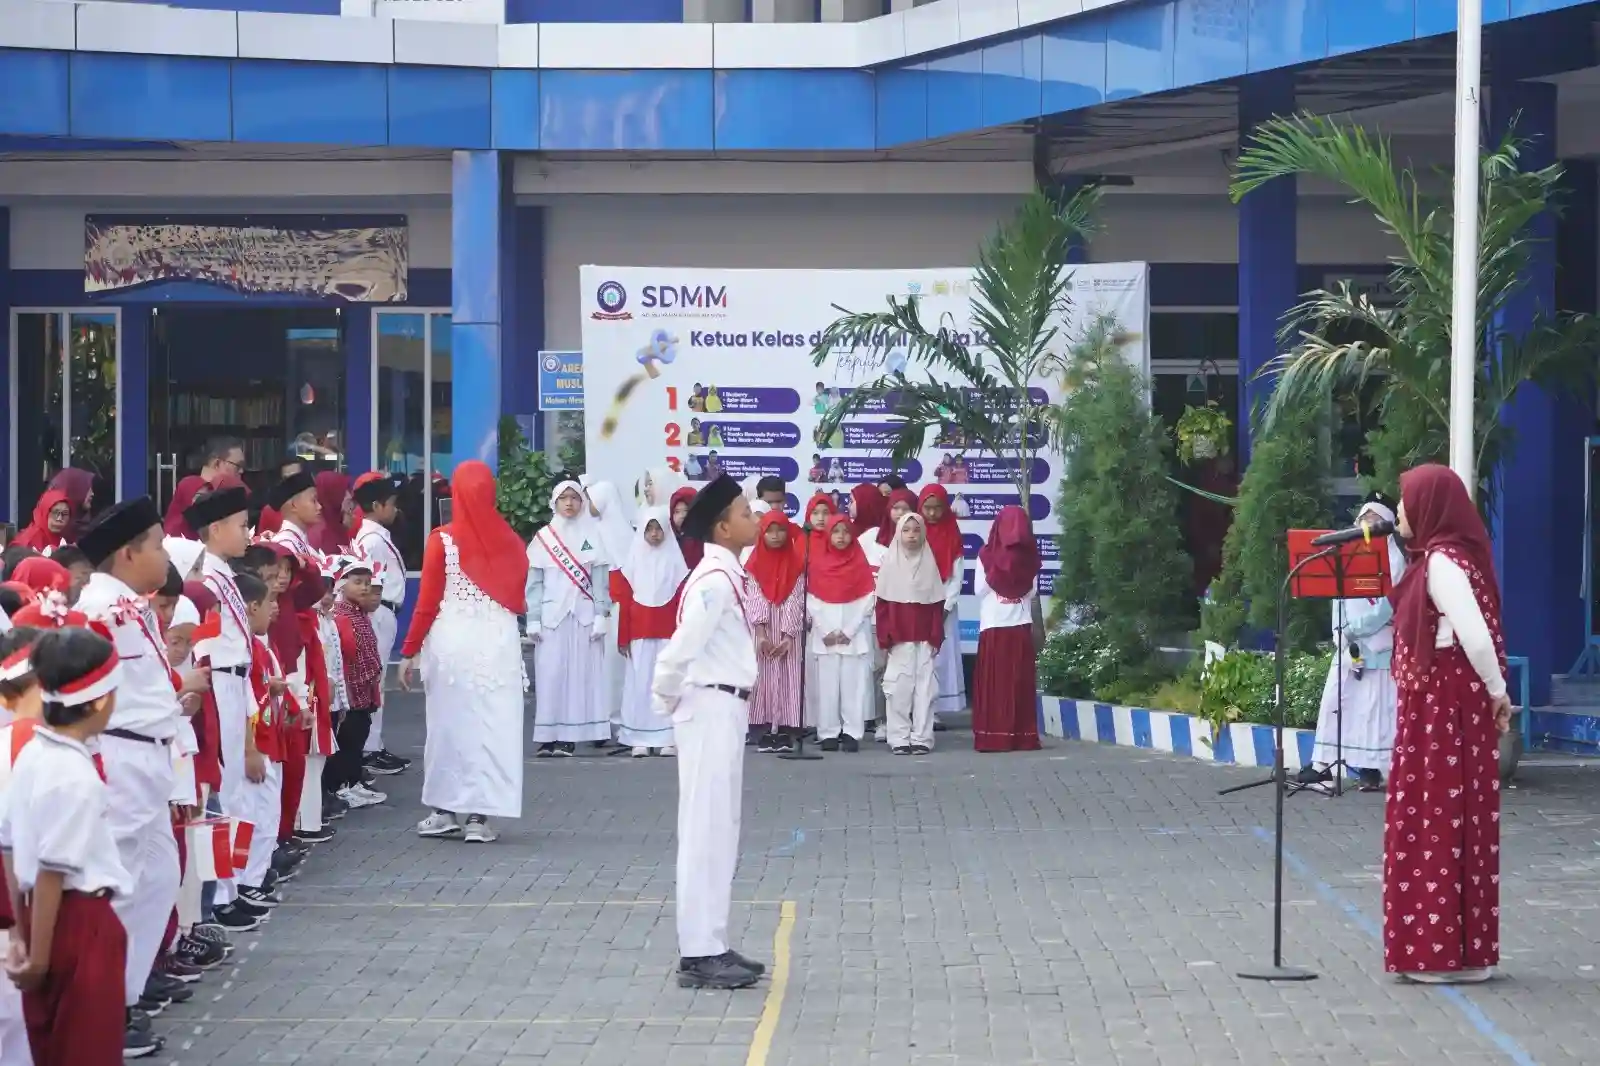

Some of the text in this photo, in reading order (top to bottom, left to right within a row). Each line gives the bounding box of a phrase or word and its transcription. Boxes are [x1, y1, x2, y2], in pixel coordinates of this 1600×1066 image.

[641, 285, 727, 308] SDMM
[690, 330, 747, 347] Ketua
[752, 330, 804, 347] Kelas
[666, 387, 677, 410] 1
[665, 423, 680, 446] 2
